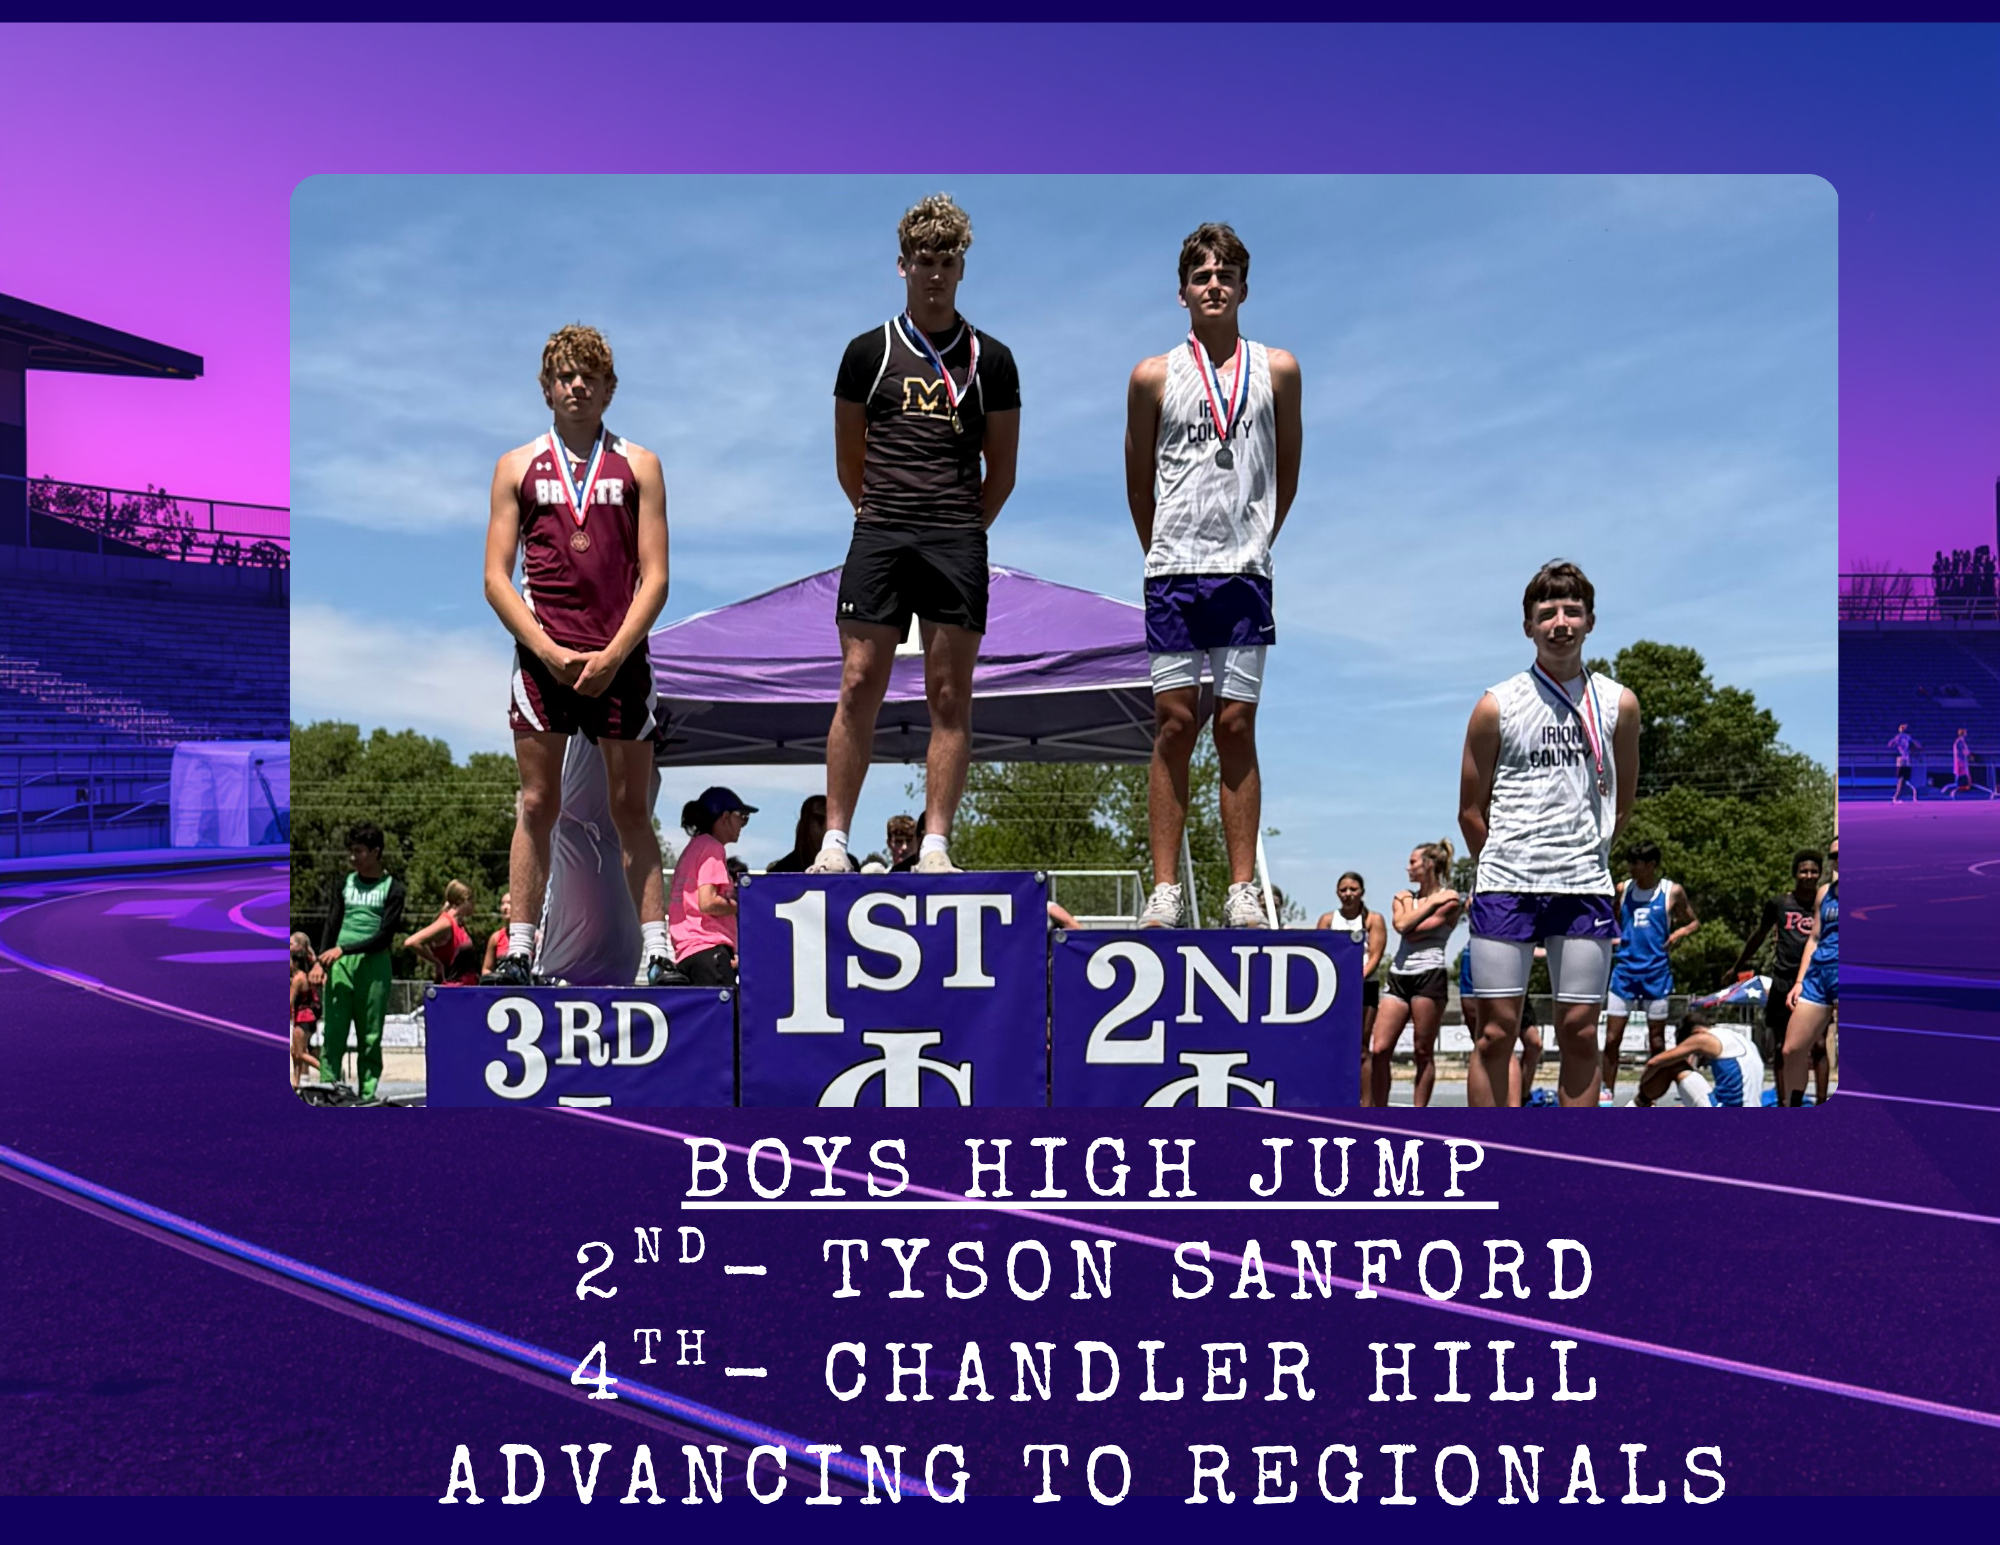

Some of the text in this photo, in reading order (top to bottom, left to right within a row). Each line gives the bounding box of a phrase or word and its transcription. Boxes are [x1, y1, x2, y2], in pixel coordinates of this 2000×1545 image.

[1187, 419, 1253, 443] COUTY
[534, 478, 625, 507] BRTE
[1542, 726, 1583, 744] IRION
[1529, 748, 1592, 768] COUNTY
[774, 889, 1013, 1034] 1ST
[1084, 940, 1338, 1065] 2ND
[484, 996, 670, 1100] 3RD
